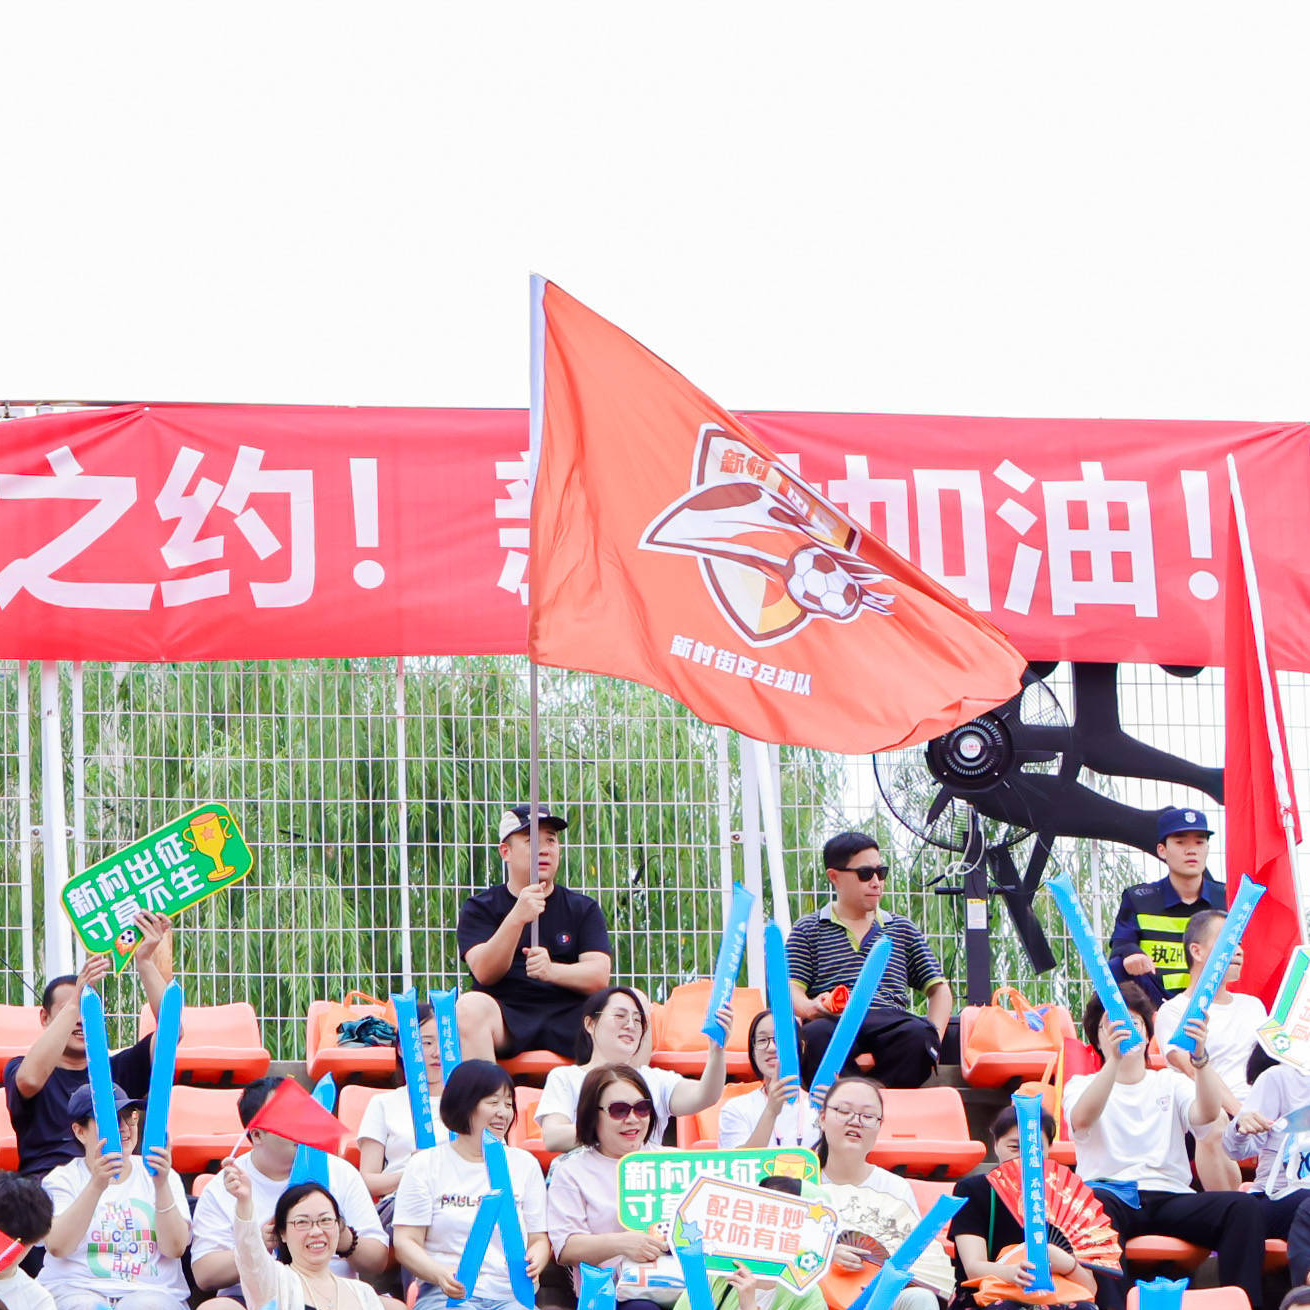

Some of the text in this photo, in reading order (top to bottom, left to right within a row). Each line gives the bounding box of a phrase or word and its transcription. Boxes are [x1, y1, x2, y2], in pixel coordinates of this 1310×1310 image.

[669, 633, 814, 698] 新村街区足球队
[65, 831, 190, 920] 新村出征
[81, 863, 207, 945] 寸草不生
[1152, 944, 1169, 964] 执
[706, 1193, 805, 1230] 配合精妙
[91, 1230, 137, 1243] GUCCI
[701, 1217, 801, 1255] 攻防有道
